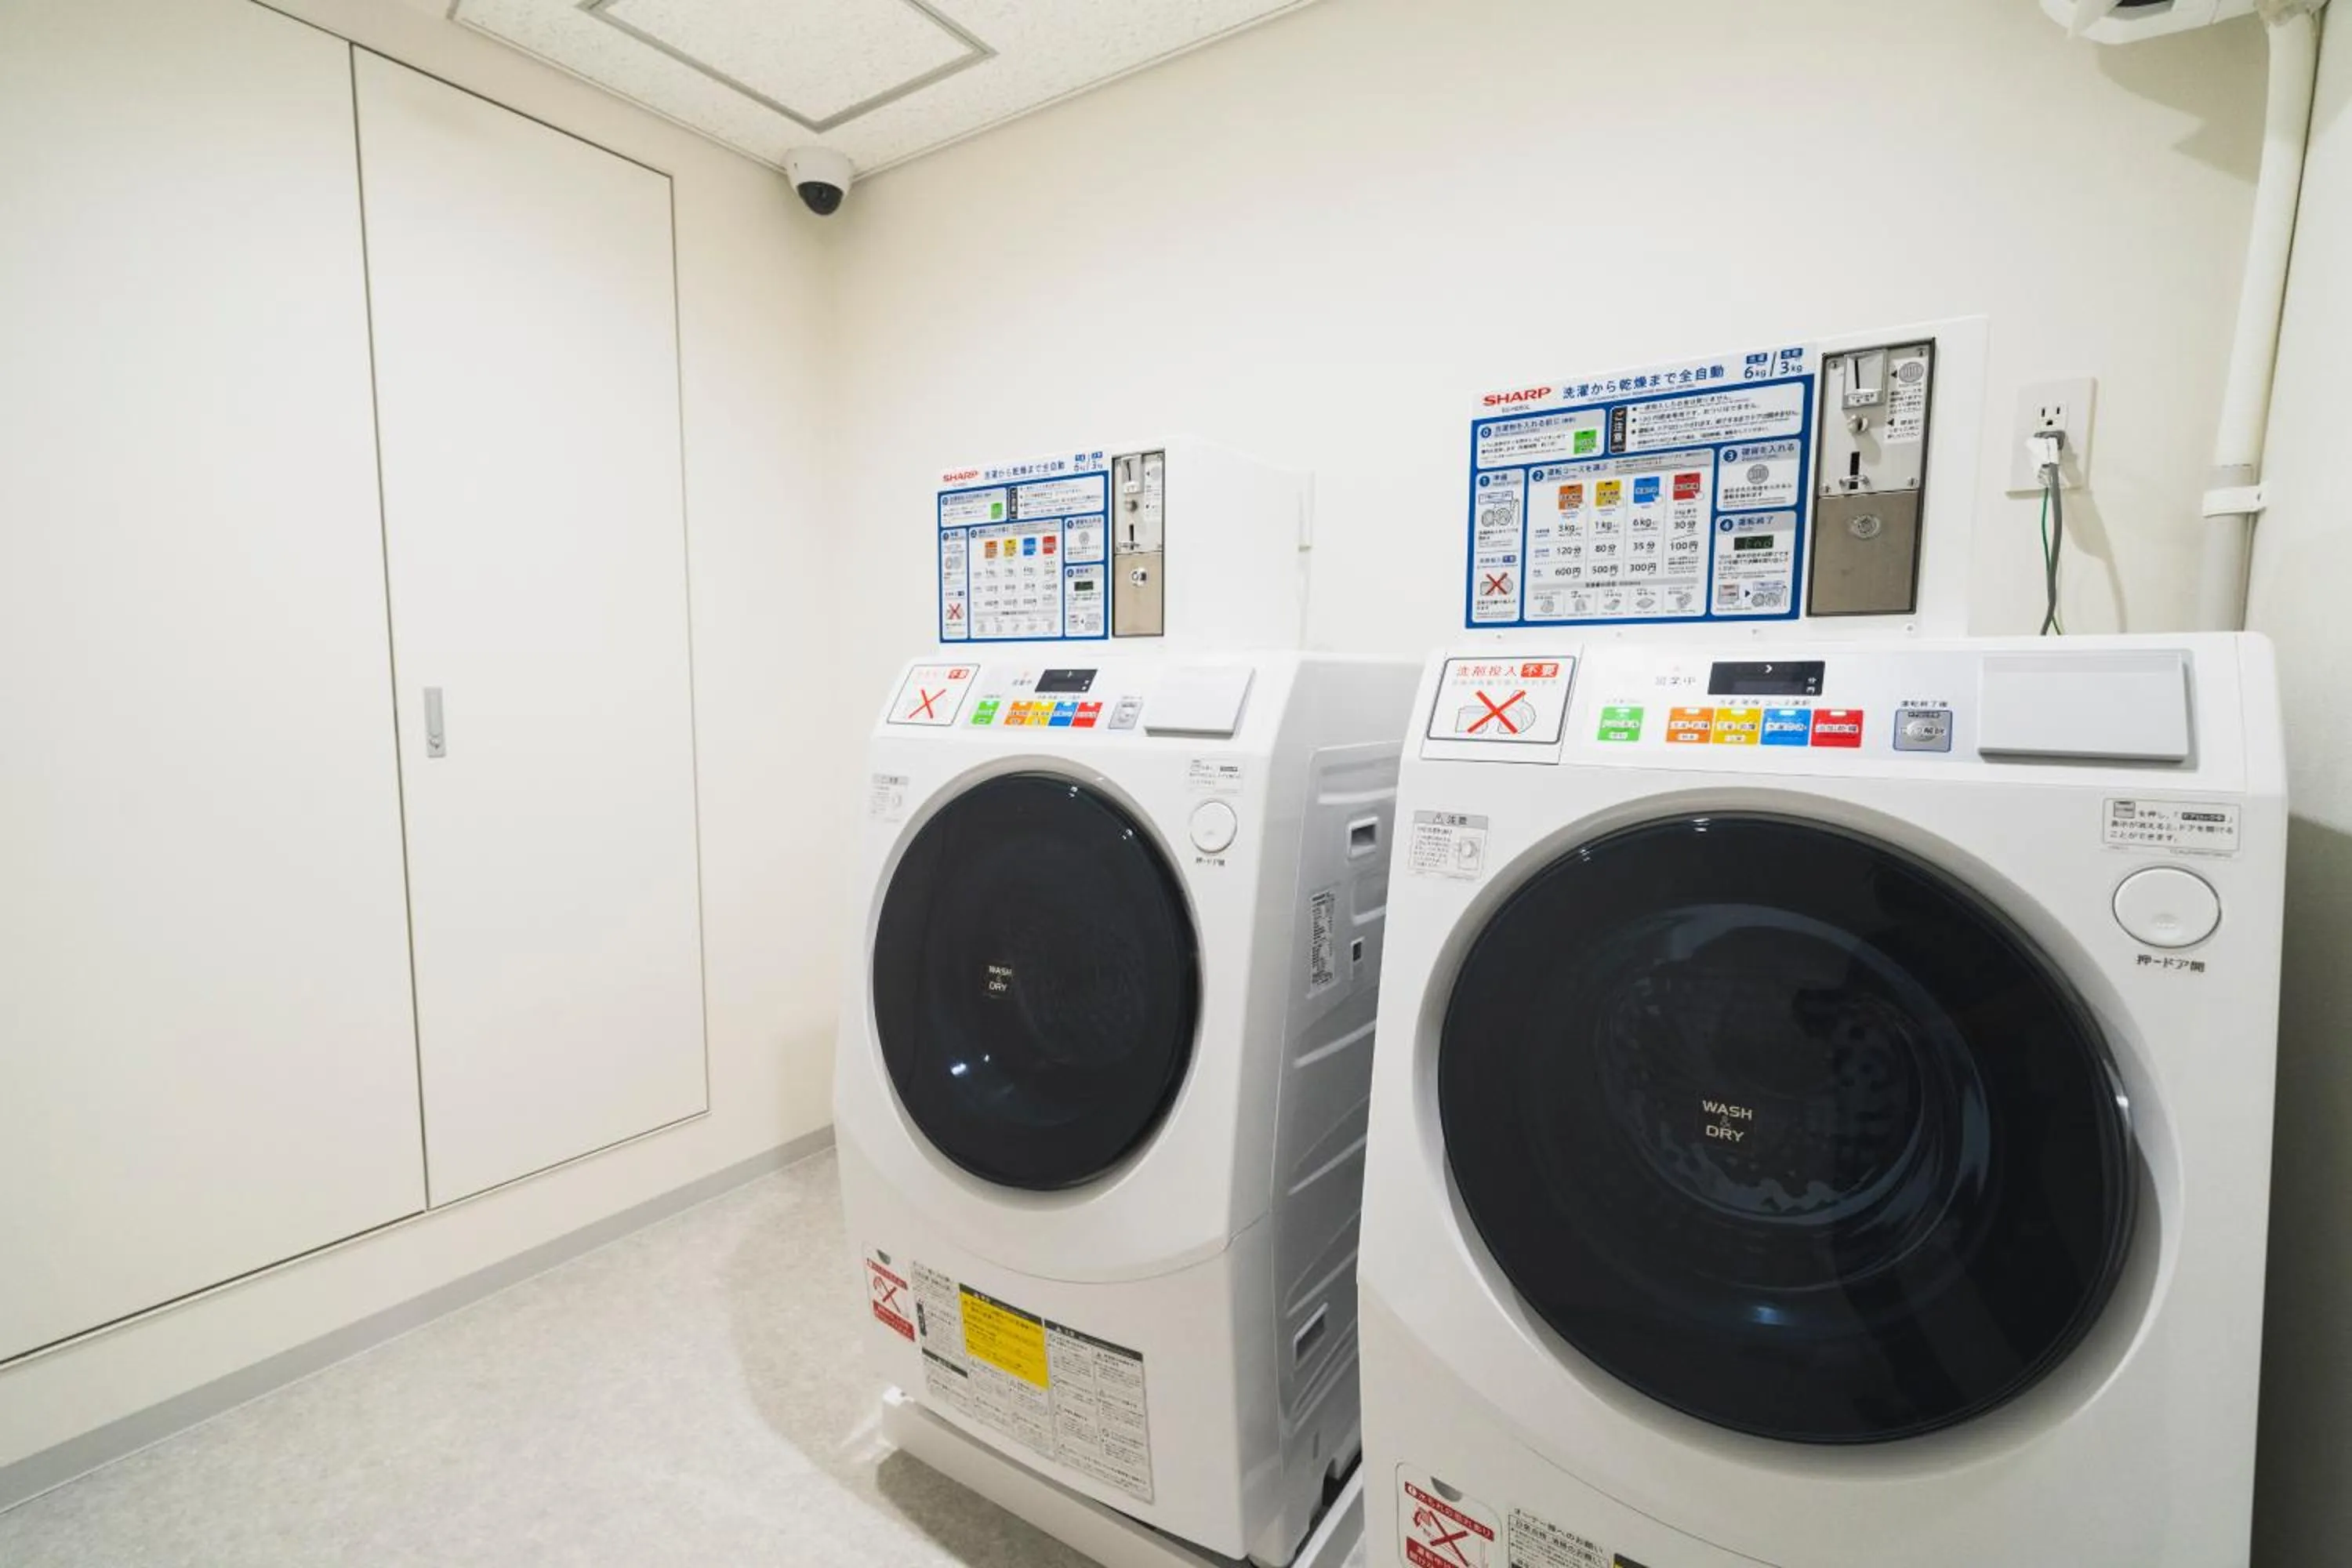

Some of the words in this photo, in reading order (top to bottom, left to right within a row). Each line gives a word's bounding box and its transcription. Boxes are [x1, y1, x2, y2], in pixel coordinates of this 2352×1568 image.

[1563, 365, 1724, 399] 洗濯から乾燥まで全自動
[1483, 387, 1552, 406] SHARP
[943, 470, 978, 482] SHARP
[1633, 518, 1651, 528] 6kg
[1675, 521, 1696, 530] 30分
[1556, 546, 1581, 556] 120分
[1595, 544, 1616, 554] 80分
[1671, 541, 1698, 551] 100円
[1555, 567, 1581, 576] 600円
[1592, 564, 1618, 575] 500円
[1630, 562, 1656, 572] 300円
[989, 965, 1012, 977] WASH
[989, 981, 1007, 992] DRY
[1702, 1099, 1752, 1121] WASH
[1706, 1124, 1744, 1142] DRY
